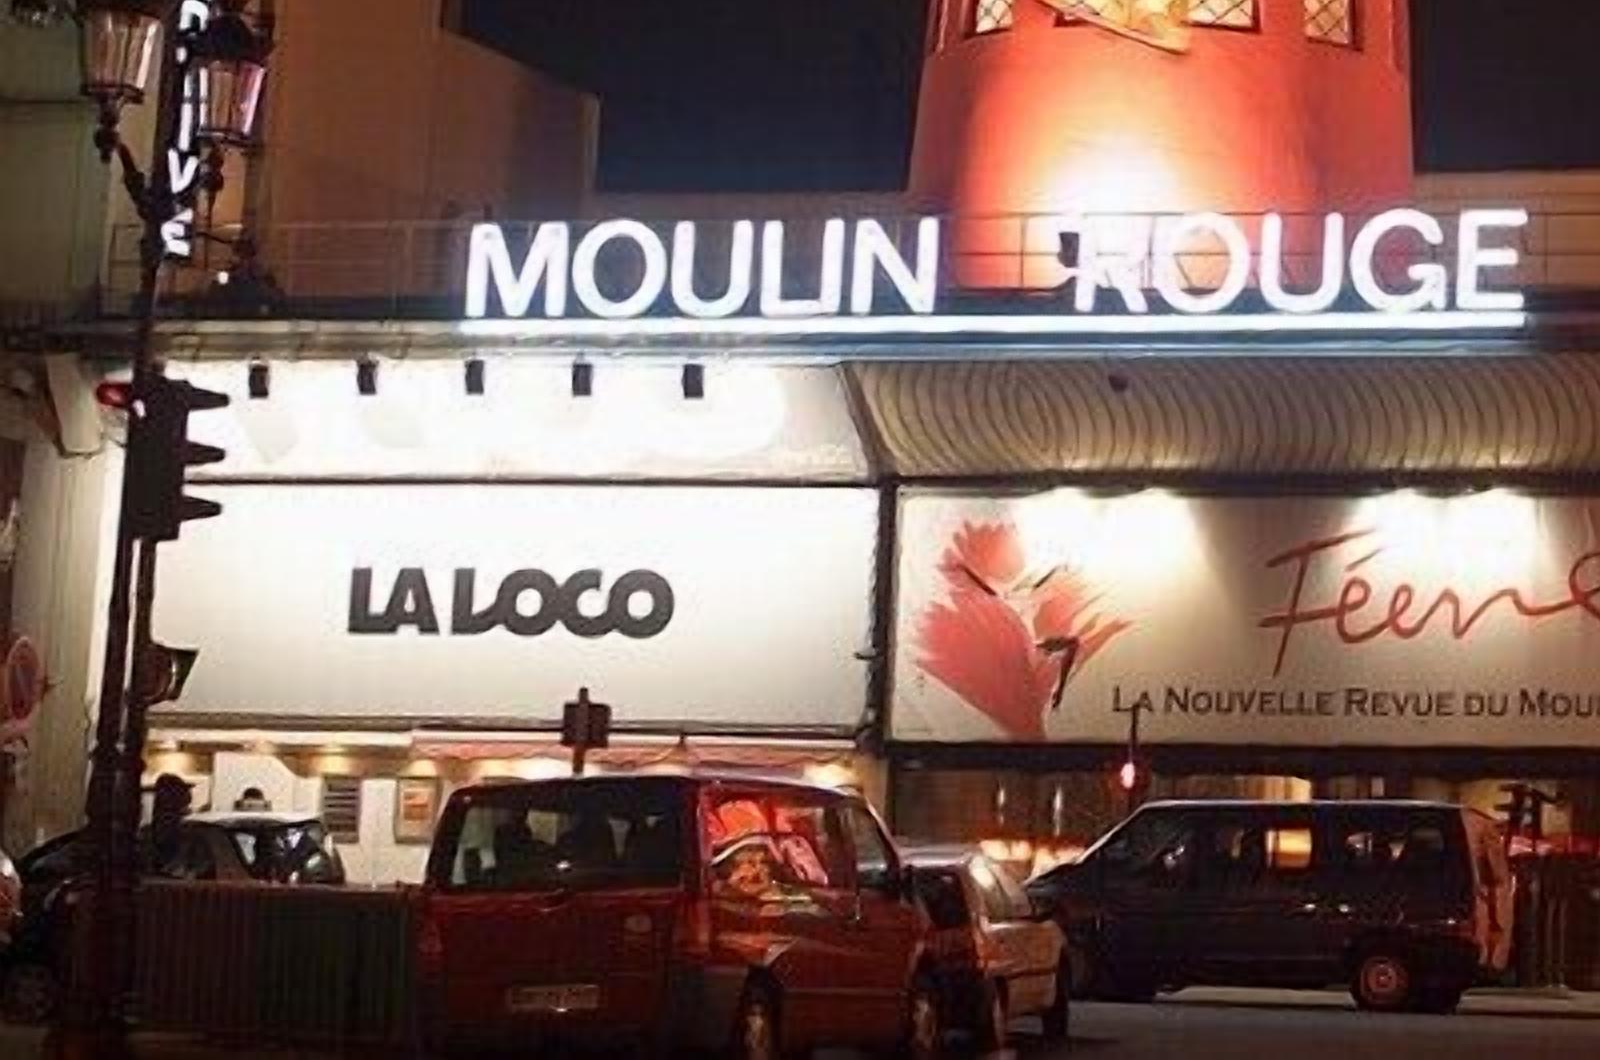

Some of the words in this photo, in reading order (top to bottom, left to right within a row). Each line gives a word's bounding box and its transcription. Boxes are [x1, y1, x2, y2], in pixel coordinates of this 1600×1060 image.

[465, 217, 940, 318] MOULIN
[1058, 206, 1529, 314] ROUGE
[347, 567, 440, 635] LA
[450, 567, 676, 639] LOCO
[1111, 685, 1154, 714] LA
[1164, 685, 1336, 717] NOUVELLE
[1343, 687, 1454, 718] REVUE
[1463, 690, 1508, 717] DU
